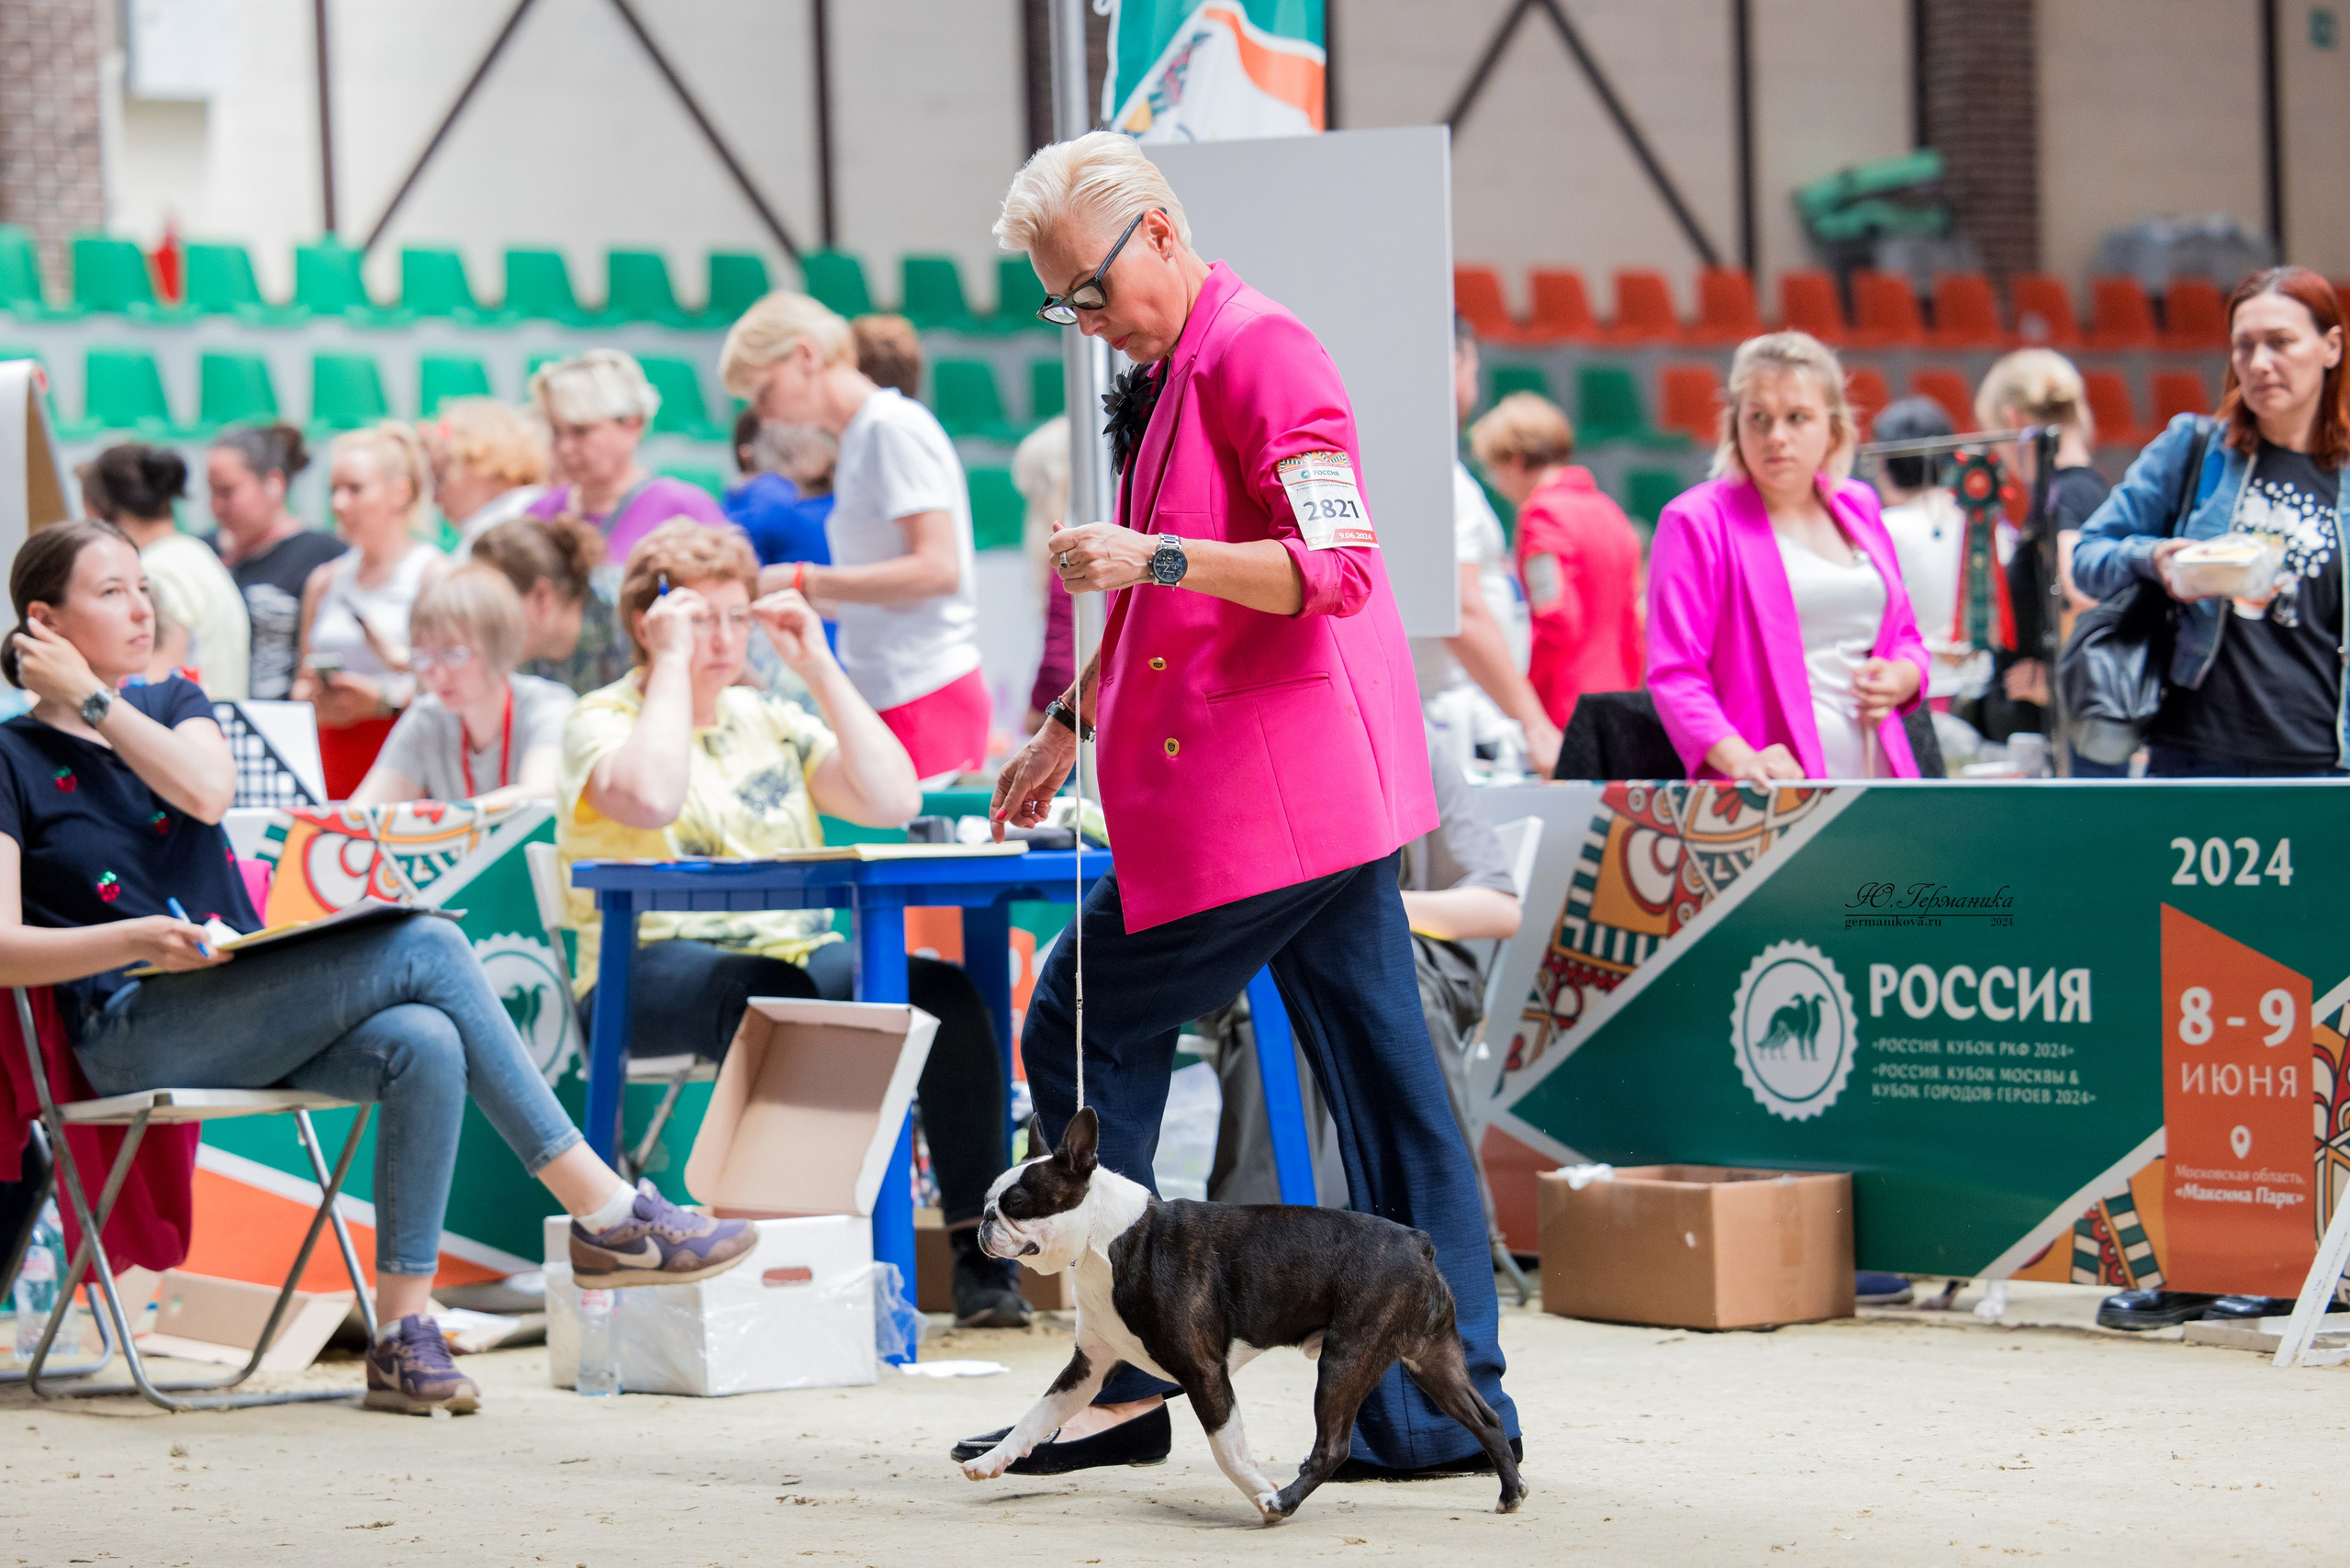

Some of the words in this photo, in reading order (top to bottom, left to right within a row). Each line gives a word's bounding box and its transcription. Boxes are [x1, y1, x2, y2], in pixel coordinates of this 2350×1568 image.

[1313, 469, 1340, 477] РОССИЯ
[1303, 498, 1360, 521] 2821
[1338, 532, 1373, 541] 9.06.2024
[2169, 836, 2294, 887] 2024
[1869, 963, 2092, 1024] РОССИЯ
[1945, 1039, 1996, 1056] КУБОК
[1998, 1040, 2031, 1057] РКФ
[1945, 1065, 1996, 1082] КУБОК
[1998, 1067, 2065, 1085] МОСКВЫ
[2068, 1069, 2080, 1086] &
[2181, 1061, 2298, 1099] ИЮНЯ
[1871, 1083, 1920, 1099] КУБОК
[2174, 1163, 2251, 1182] Московская
[2174, 1182, 2253, 1204] «Максима
[2255, 1185, 2306, 1211] Парк»
